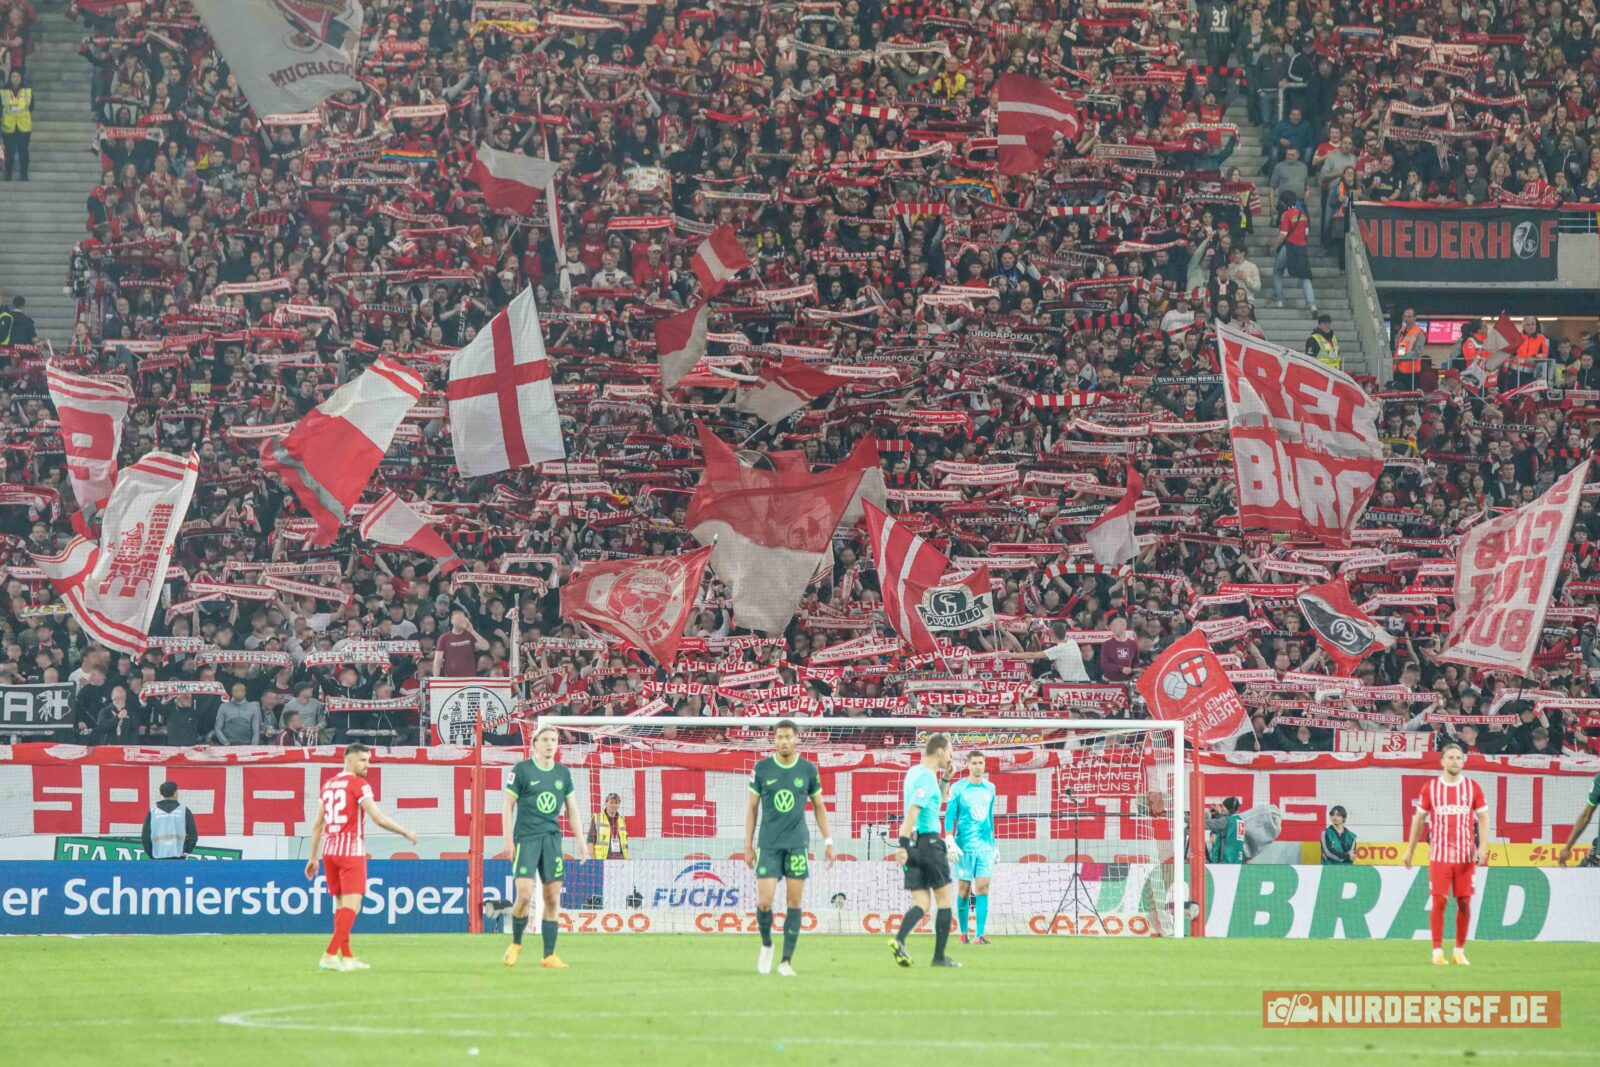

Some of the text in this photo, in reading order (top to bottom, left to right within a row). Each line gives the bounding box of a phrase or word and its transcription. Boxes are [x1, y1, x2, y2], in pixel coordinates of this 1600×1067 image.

[1359, 218, 1558, 260] NIEDERHOF
[1222, 338, 1366, 442] FREI
[1232, 437, 1376, 529] BURG
[924, 605, 984, 628] CORRILLO
[1402, 693, 1438, 701] FREIBURG
[1481, 716, 1517, 724] FREIBURG
[1061, 769, 1142, 781] FÜR IMMER
[32, 765, 718, 840] SPOR-CUB
[323, 789, 348, 824] 32
[1353, 845, 1399, 860] OTTO
[790, 855, 807, 872] 22
[64, 876, 337, 916] Schmierstof
[653, 888, 741, 908] FUCHS
[556, 913, 651, 933] AZOO
[862, 913, 976, 934] CAZ
[1028, 914, 1150, 936] CAZOO
